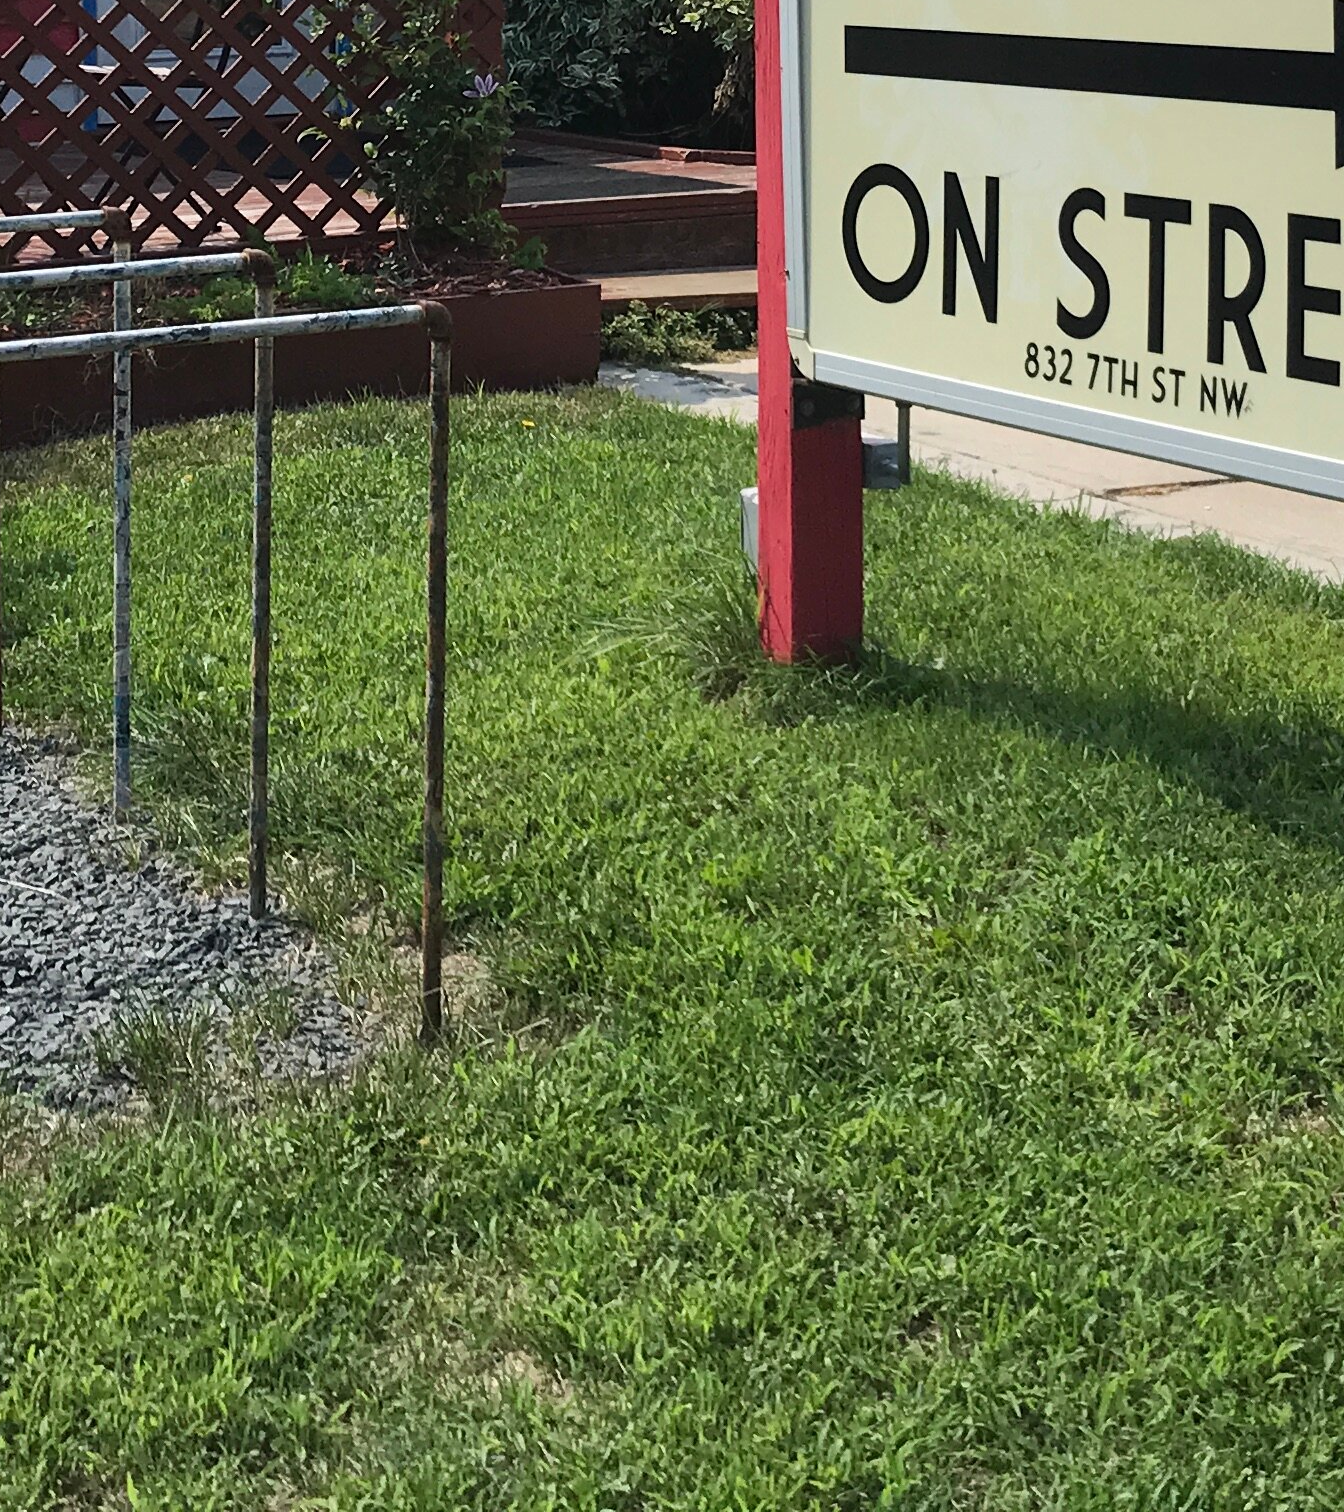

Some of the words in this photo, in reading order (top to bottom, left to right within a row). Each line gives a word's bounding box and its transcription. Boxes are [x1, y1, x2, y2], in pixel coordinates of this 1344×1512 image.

[842, 164, 999, 324] ON
[1024, 341, 1074, 386] 832
[1087, 352, 1139, 399] 7TH
[1151, 366, 1186, 407] ST
[1200, 373, 1248, 419] NW
